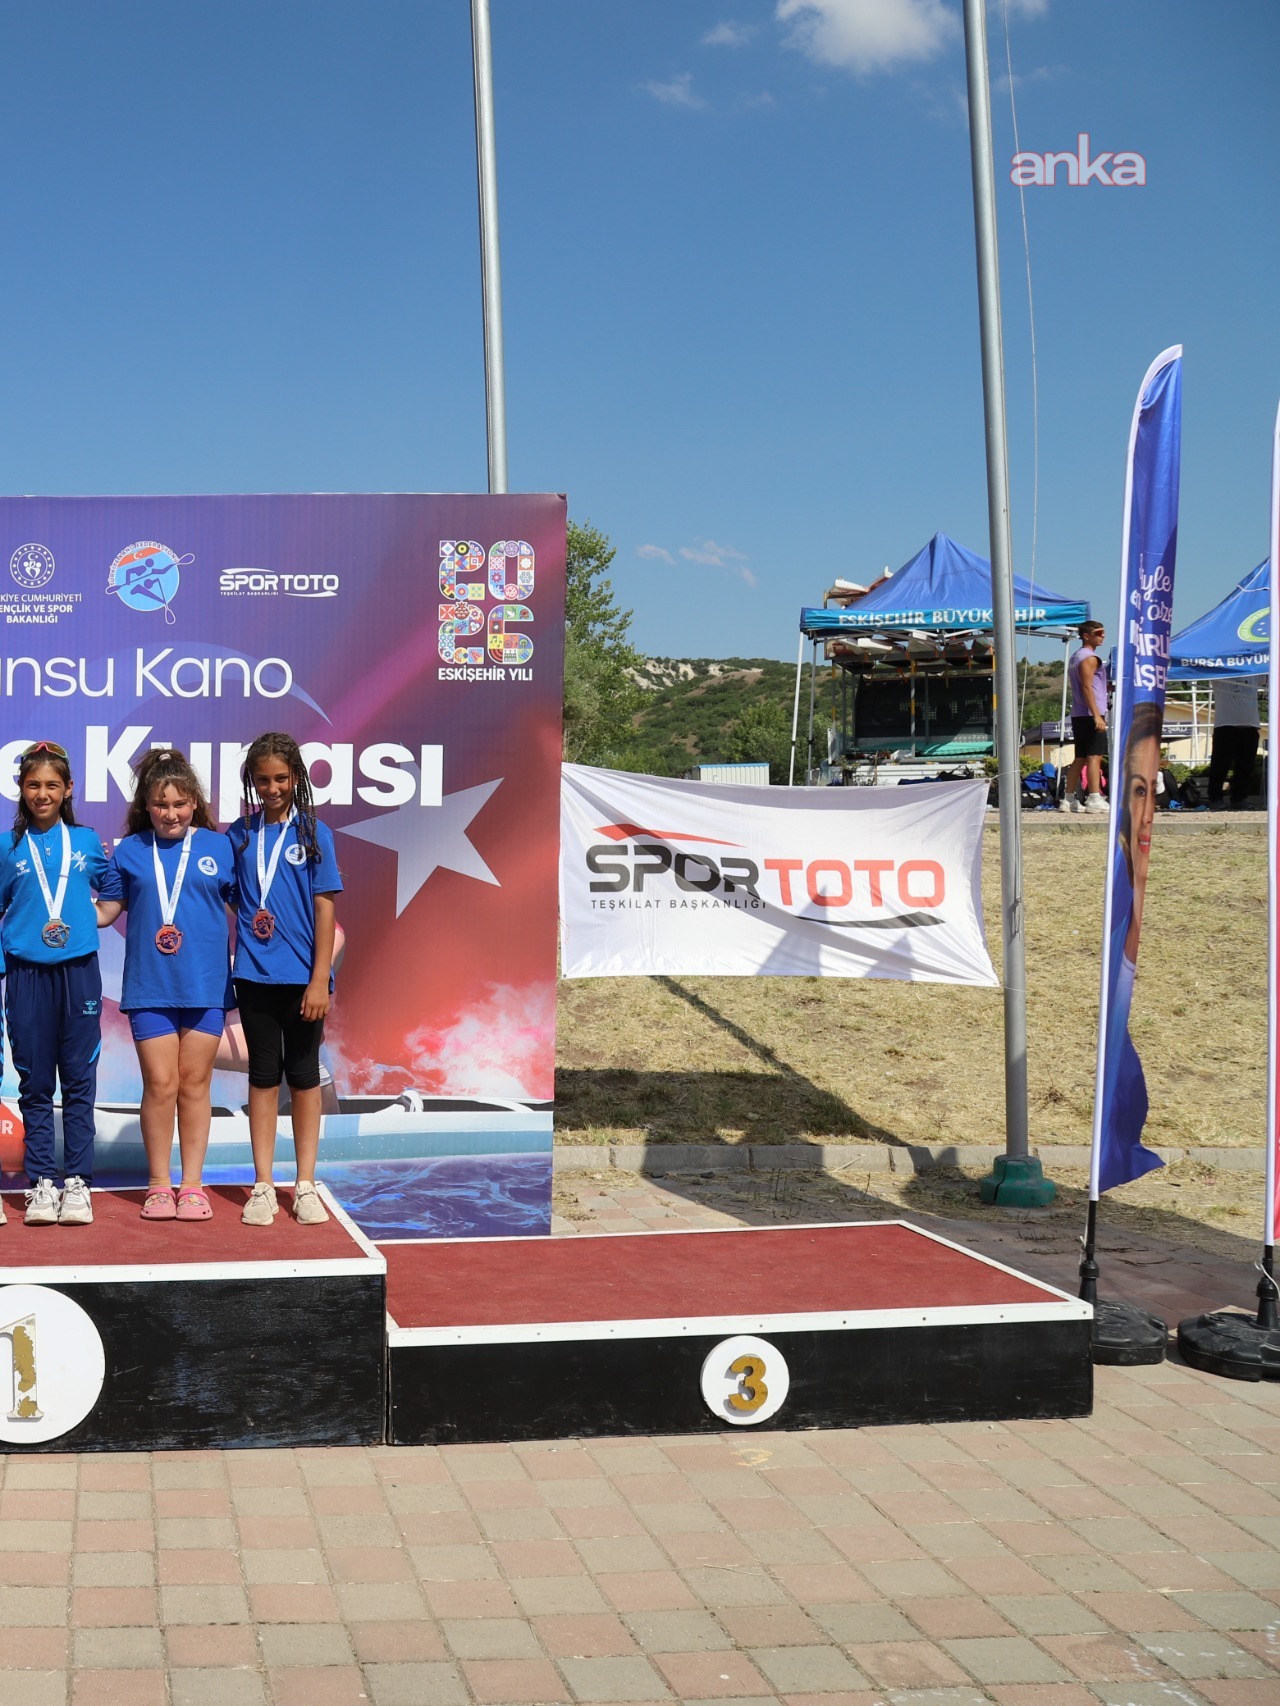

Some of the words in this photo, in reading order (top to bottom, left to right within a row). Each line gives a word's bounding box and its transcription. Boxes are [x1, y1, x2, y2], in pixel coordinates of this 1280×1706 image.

[21, 593, 82, 603] CUMHURİYETİ
[33, 604, 46, 613] VE
[47, 604, 73, 613] SPOR
[6, 613, 58, 624] BAKANLIĞI
[838, 611, 926, 629] ESKİŞEHİR
[932, 606, 1047, 624] BÜYÜKHİR
[1181, 658, 1224, 668] BURSA
[136, 647, 293, 698] Kano
[438, 665, 506, 682] ESKİŞEHİR
[509, 668, 533, 681] YILI
[591, 896, 661, 910] TEŞKİLAT
[669, 898, 768, 910] BAŞKANLIĞI
[726, 1354, 767, 1411] 3
